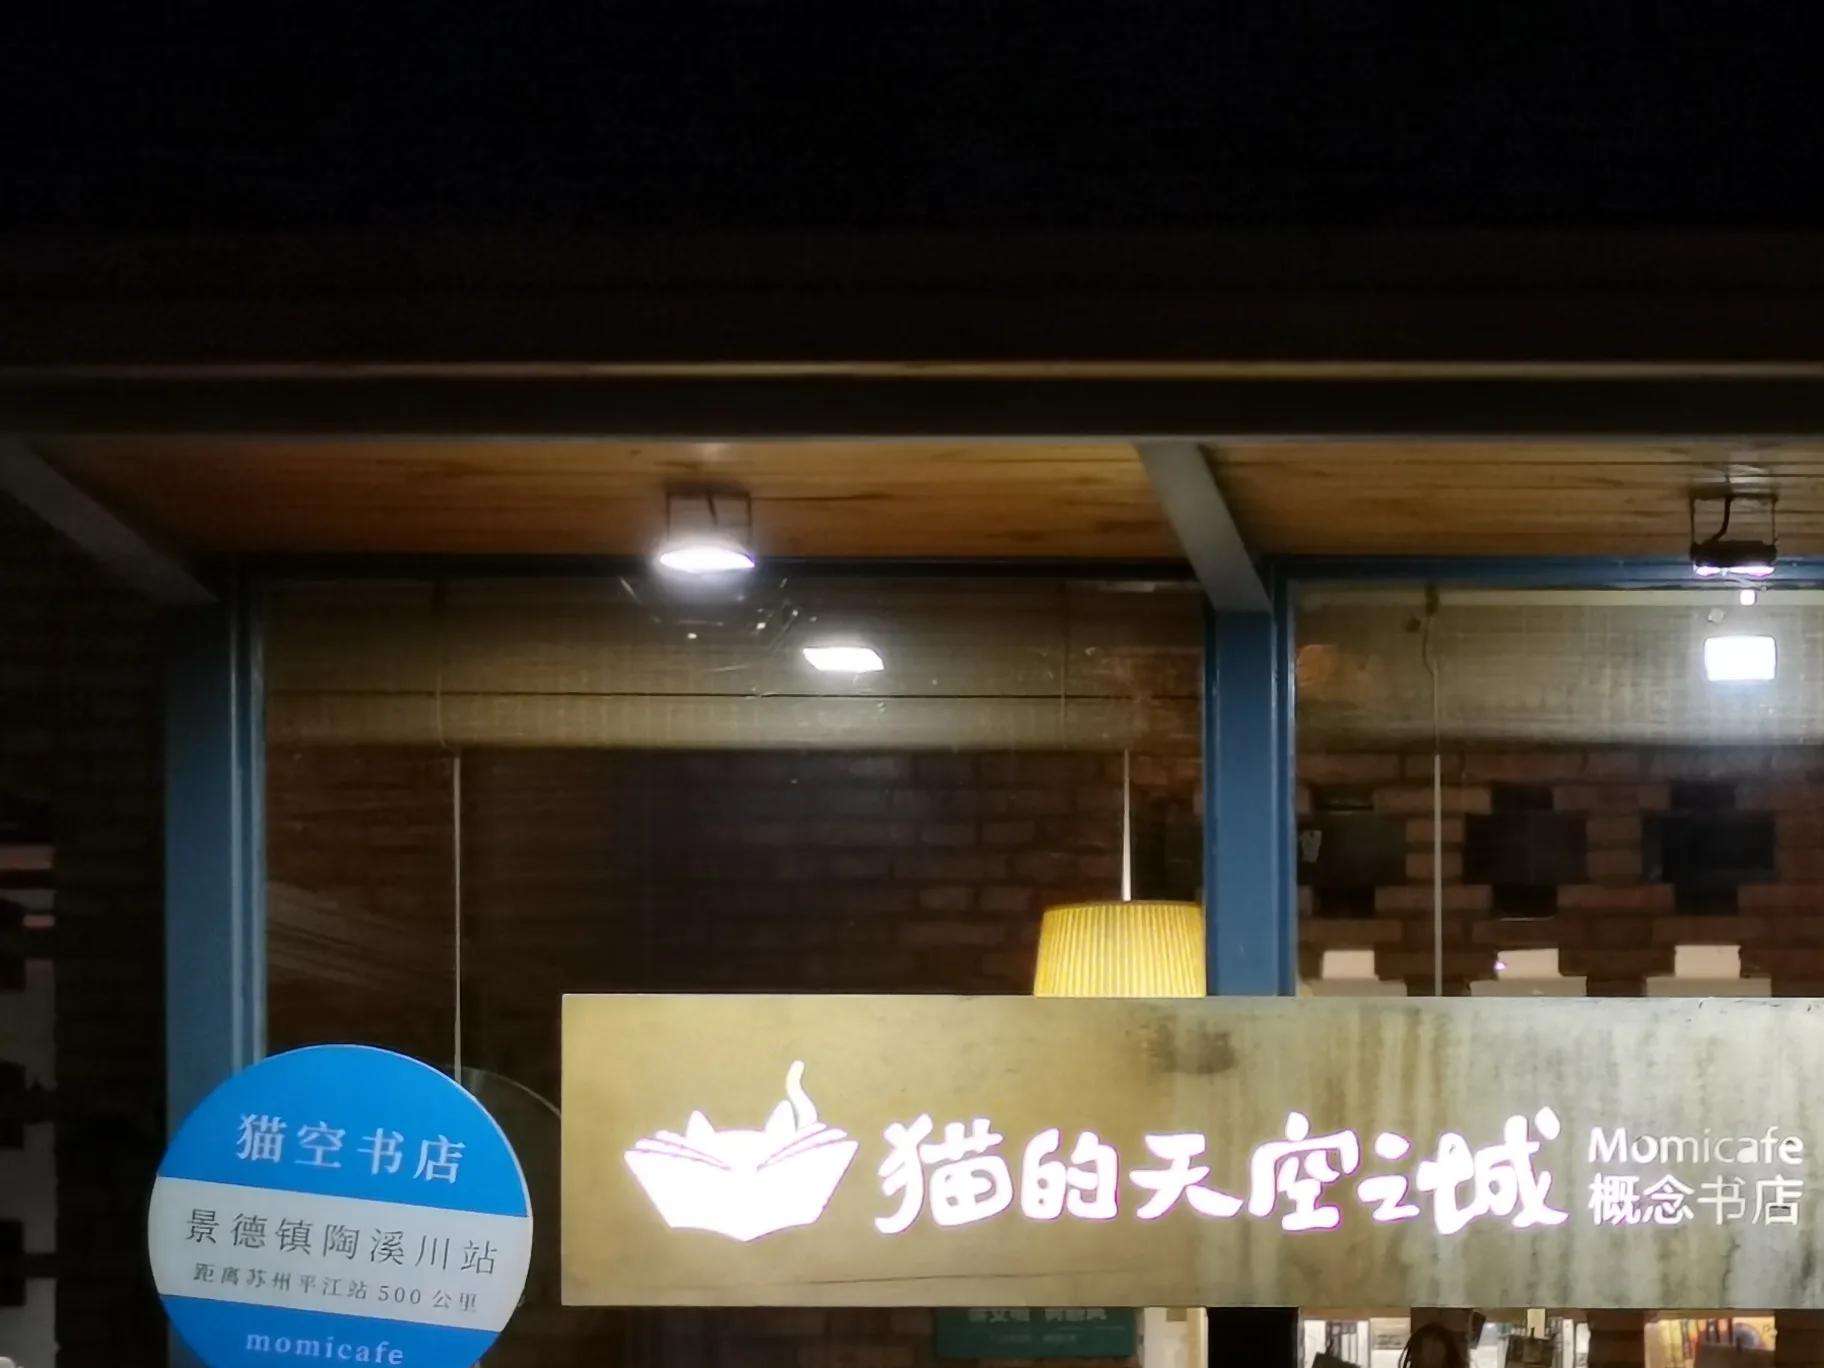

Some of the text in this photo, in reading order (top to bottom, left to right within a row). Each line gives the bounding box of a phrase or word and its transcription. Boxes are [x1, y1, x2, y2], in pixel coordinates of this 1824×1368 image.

[235, 1112, 466, 1184] 猫空书店
[874, 1106, 1568, 1235] 猫的天空之城
[1588, 1126, 1804, 1165] Momicafe
[1588, 1173, 1804, 1225] 概念书店
[186, 1208, 499, 1276] 景德镇陶溪川站
[245, 1331, 404, 1366] momicafe
